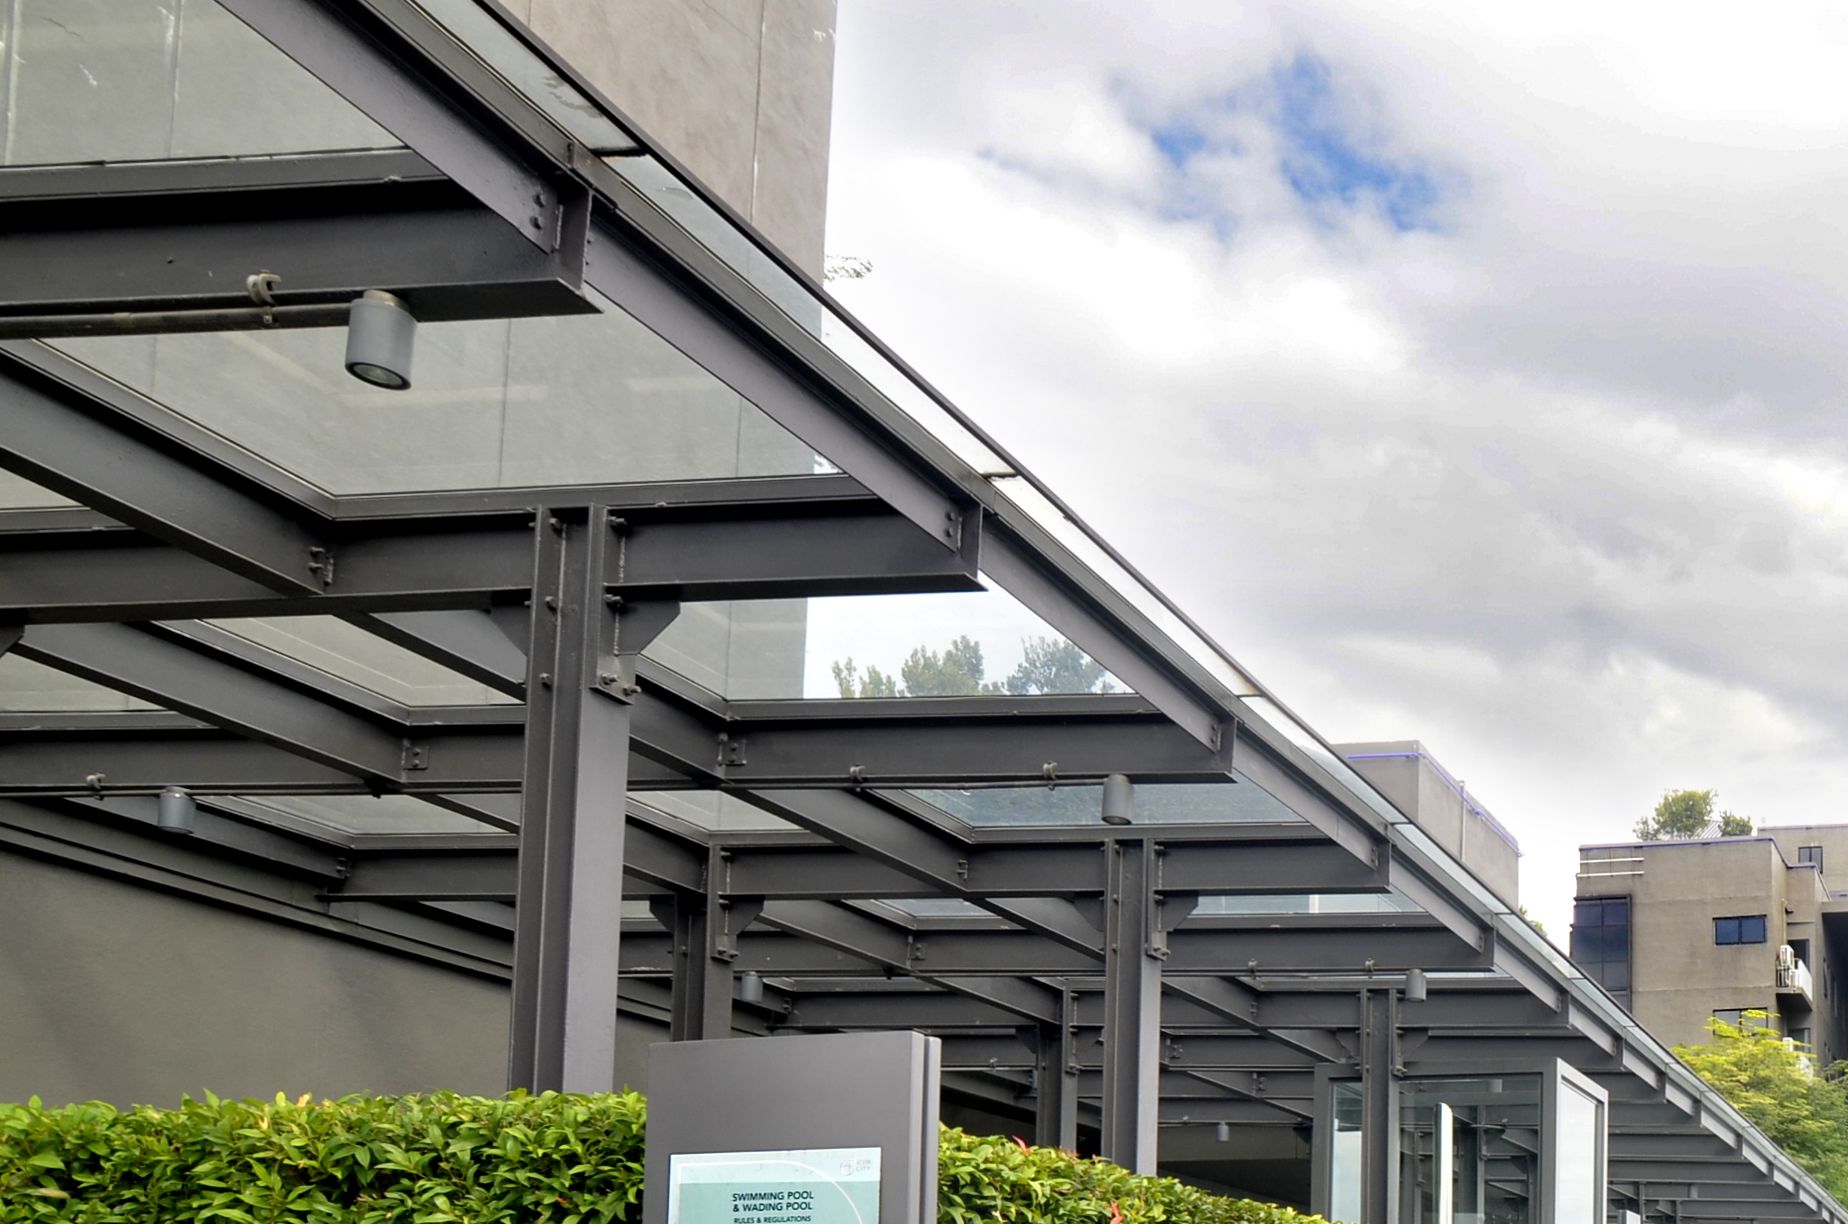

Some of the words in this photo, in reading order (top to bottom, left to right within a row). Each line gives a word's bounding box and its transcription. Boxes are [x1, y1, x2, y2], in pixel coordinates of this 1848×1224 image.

[732, 1191, 785, 1202] SWIMMING
[787, 1190, 815, 1200] POOL
[732, 1203, 740, 1213] &
[742, 1202, 783, 1212] WADING
[785, 1201, 813, 1211] POOL
[733, 1217, 755, 1224] RULES
[763, 1215, 812, 1224] REGULATIONS
